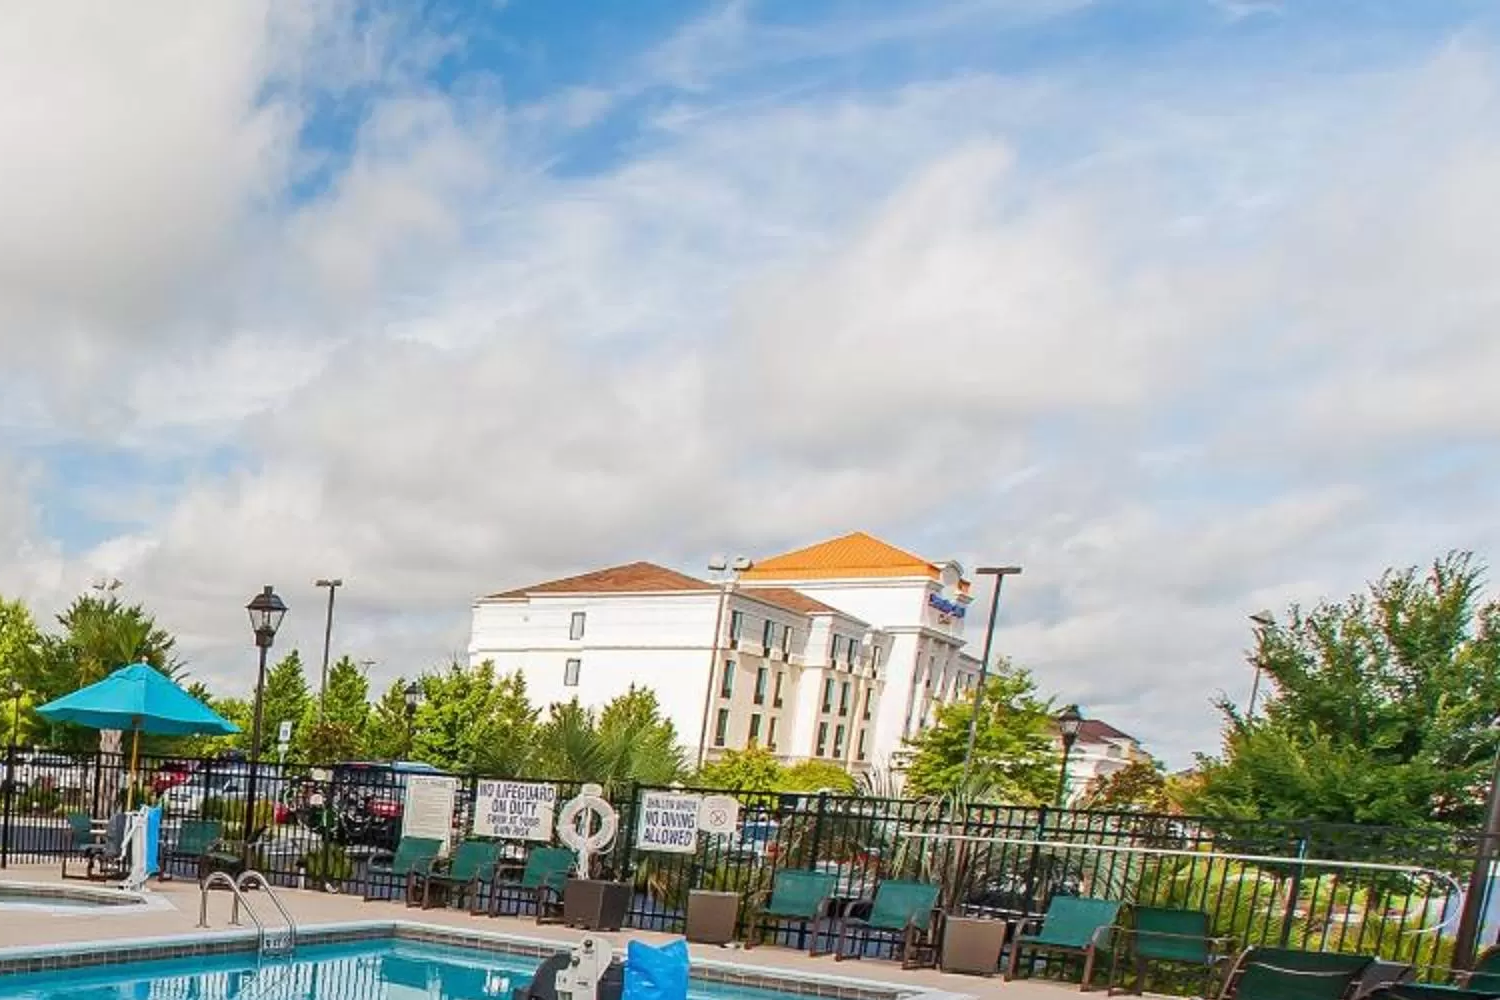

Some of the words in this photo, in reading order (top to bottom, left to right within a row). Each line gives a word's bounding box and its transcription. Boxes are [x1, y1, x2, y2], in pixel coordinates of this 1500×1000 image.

[479, 783, 495, 797] NO
[496, 783, 555, 802] LIFEGUARD
[491, 799, 507, 812] ON
[509, 800, 538, 817] DUTY
[645, 811, 659, 826] NO
[661, 811, 695, 829] DIVING
[644, 827, 693, 846] ALLOWED
